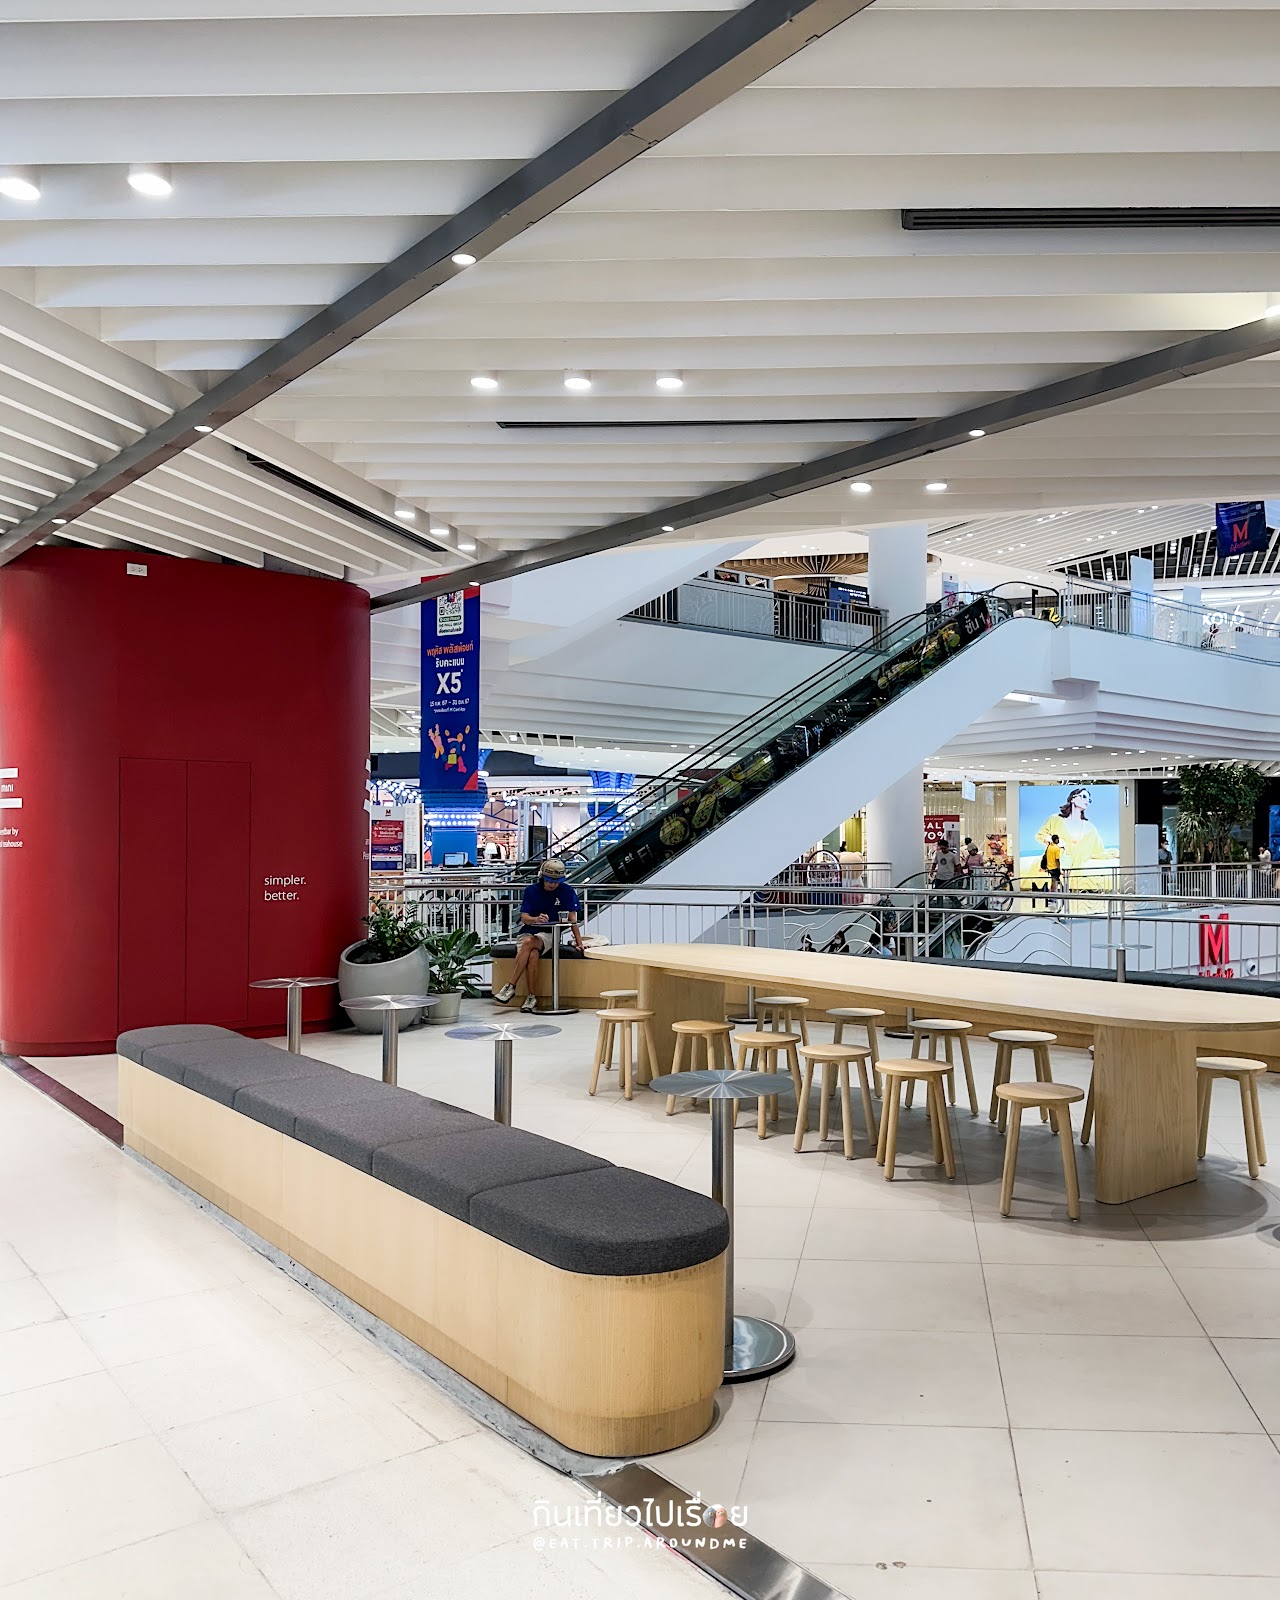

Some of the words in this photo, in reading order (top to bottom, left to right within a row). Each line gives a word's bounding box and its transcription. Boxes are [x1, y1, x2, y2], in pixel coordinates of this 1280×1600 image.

[1232, 519, 1249, 543] M
[435, 657, 465, 668] รับคะแนน
[264, 874, 307, 888] simpler.
[264, 889, 300, 902] better.
